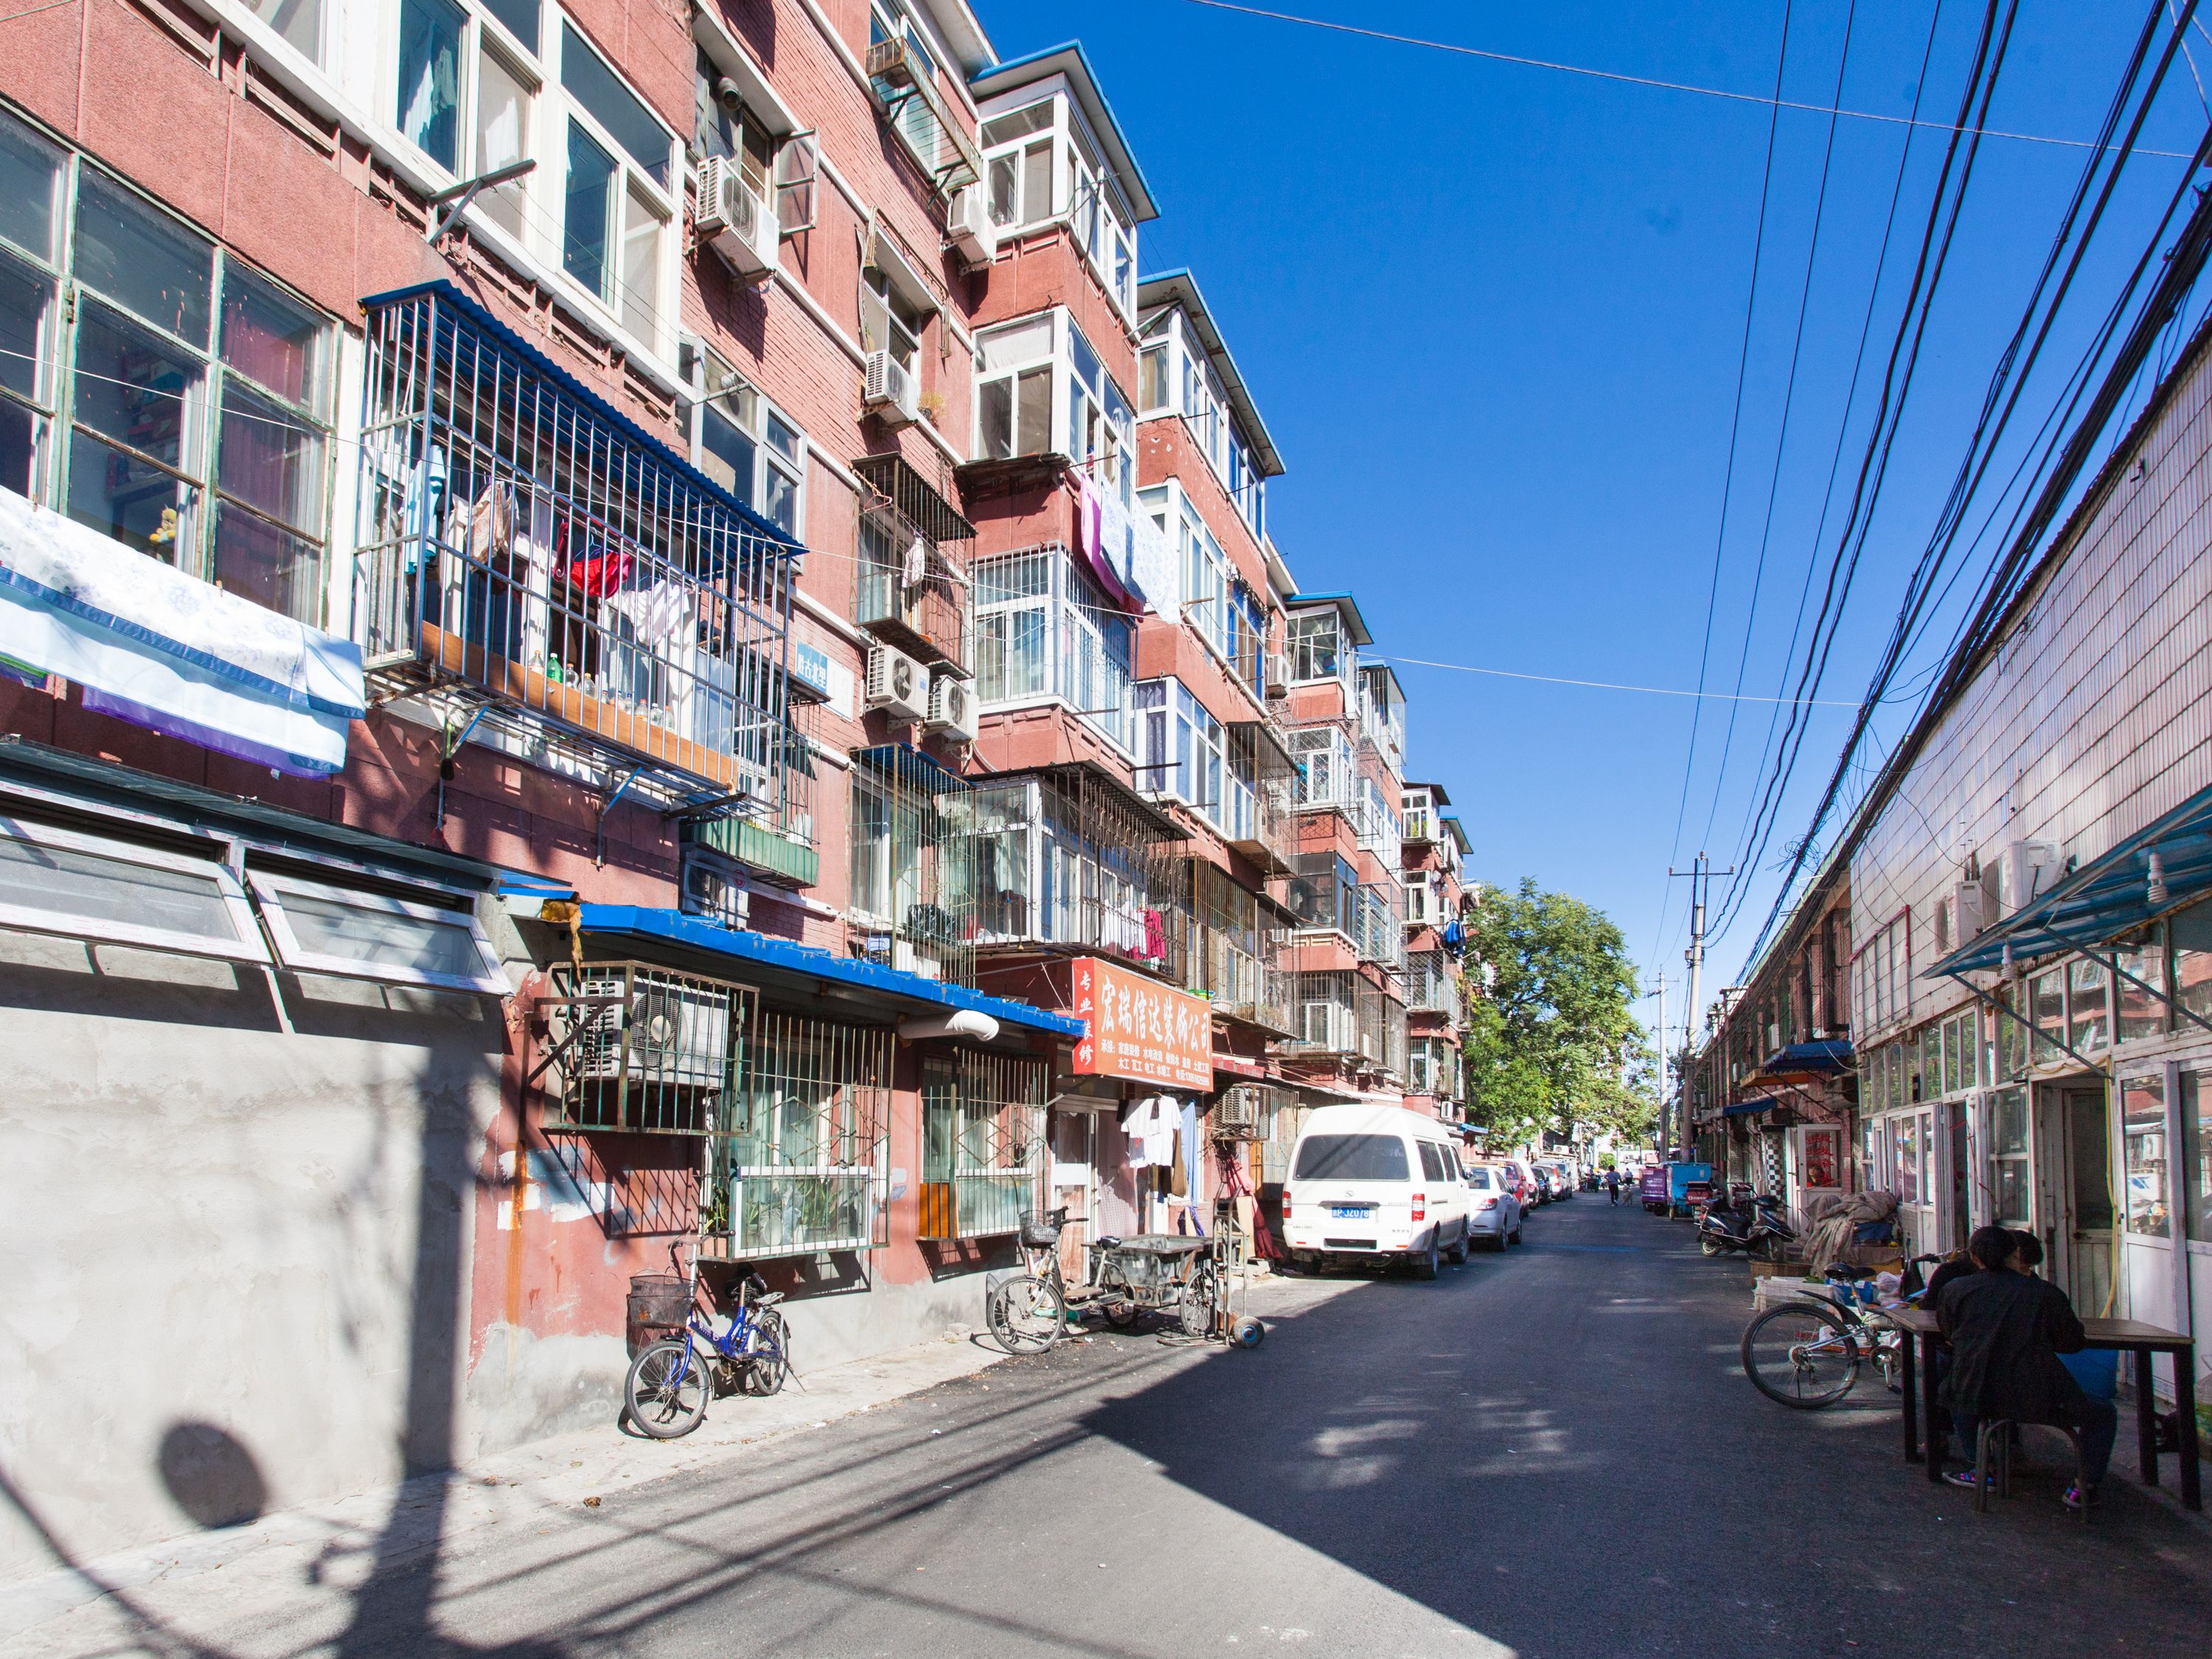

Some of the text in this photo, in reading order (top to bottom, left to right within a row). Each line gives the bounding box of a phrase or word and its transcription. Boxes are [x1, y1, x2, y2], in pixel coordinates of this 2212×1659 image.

[1079, 970, 1094, 1066] 专业装修
[1101, 974, 1210, 1060] 宏瑞信达装饰公司
[1118, 1057, 1130, 1071] 木工
[1144, 1061, 1155, 1074] 电工
